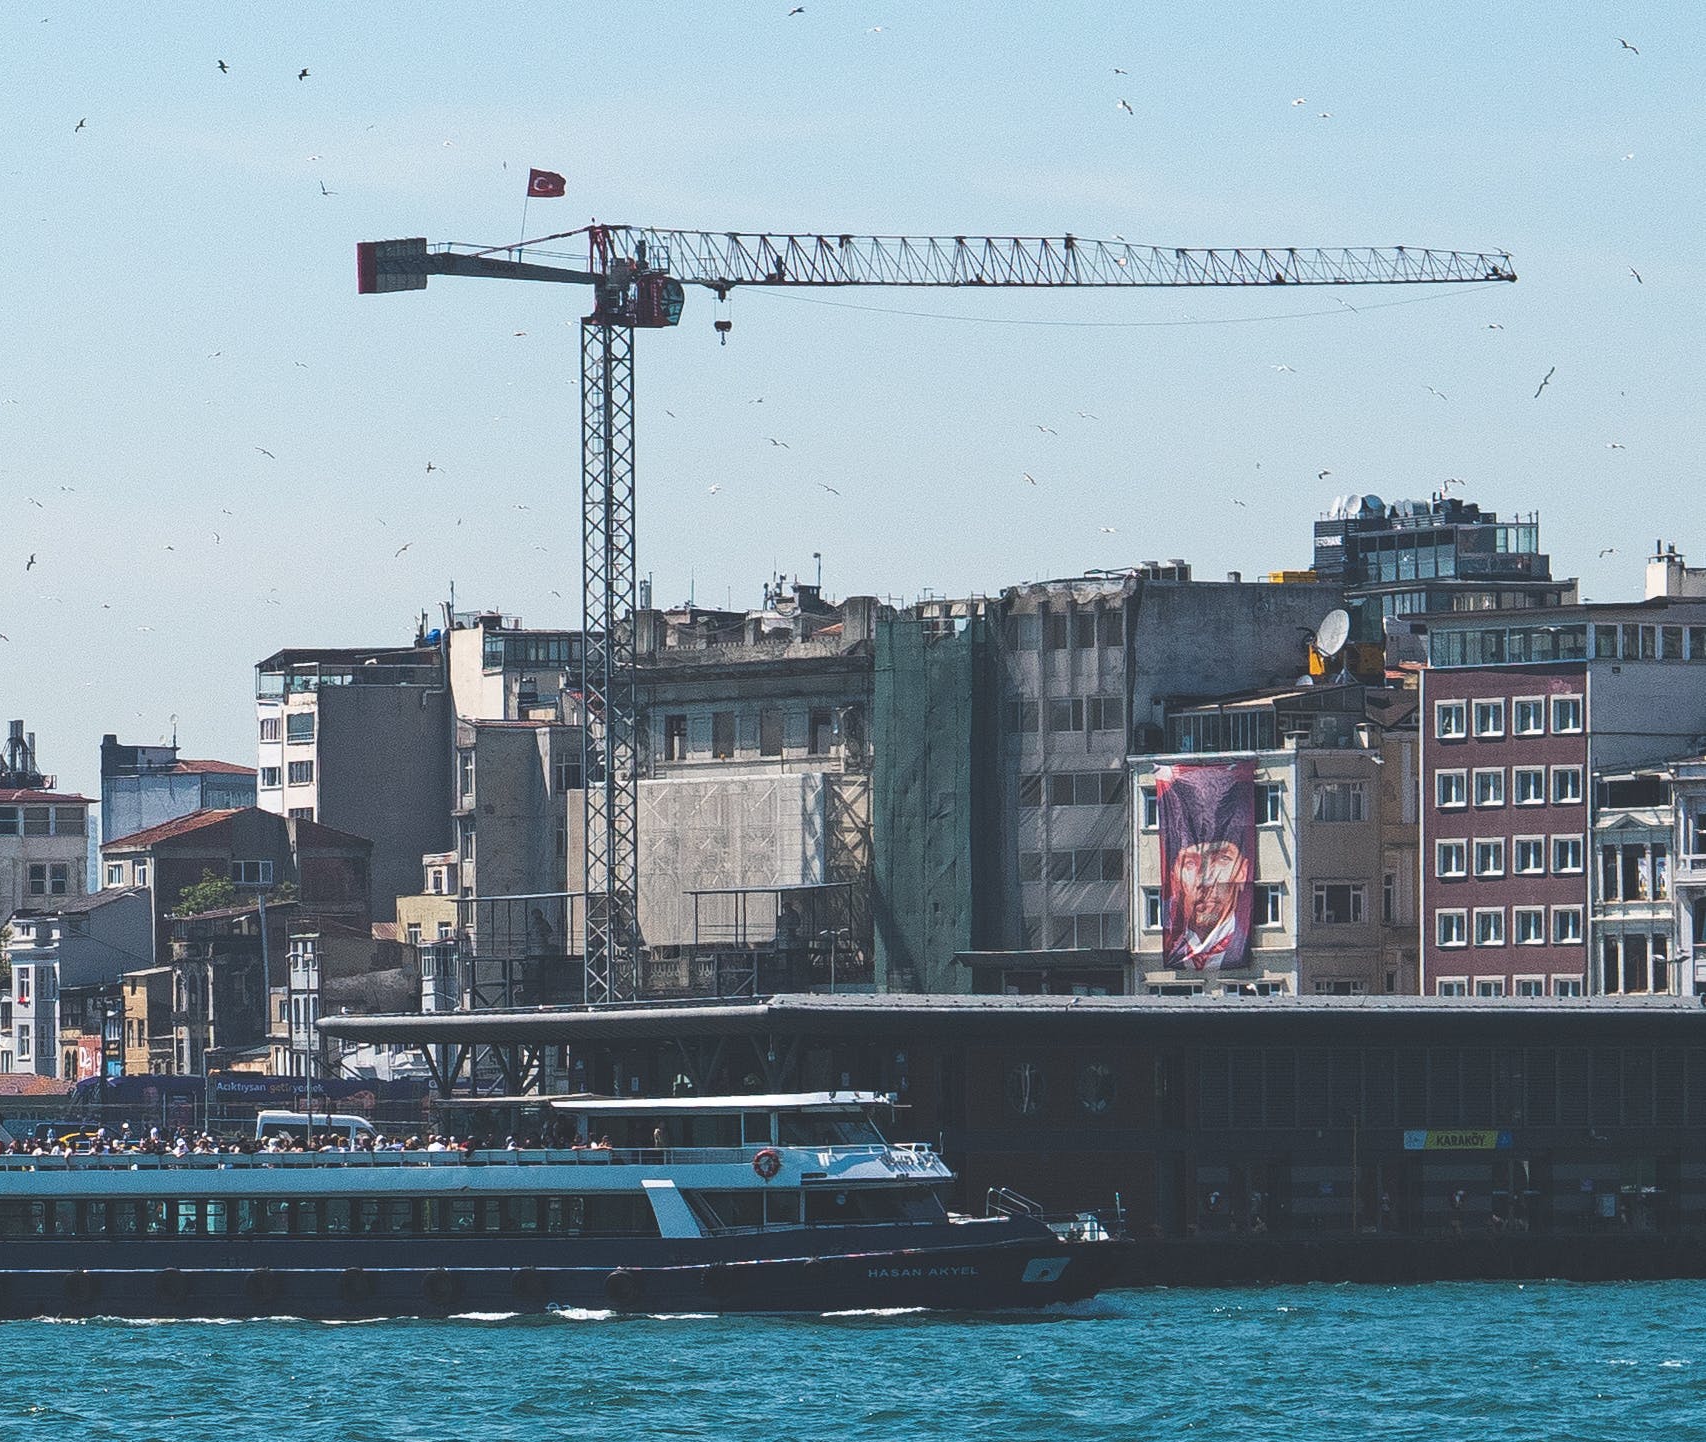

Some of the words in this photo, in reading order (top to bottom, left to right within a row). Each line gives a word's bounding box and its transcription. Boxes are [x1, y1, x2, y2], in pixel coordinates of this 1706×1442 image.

[1436, 1132, 1486, 1147] KARAKÖY
[867, 1268, 922, 1278] HASAN
[927, 1266, 979, 1278] AKYEL
